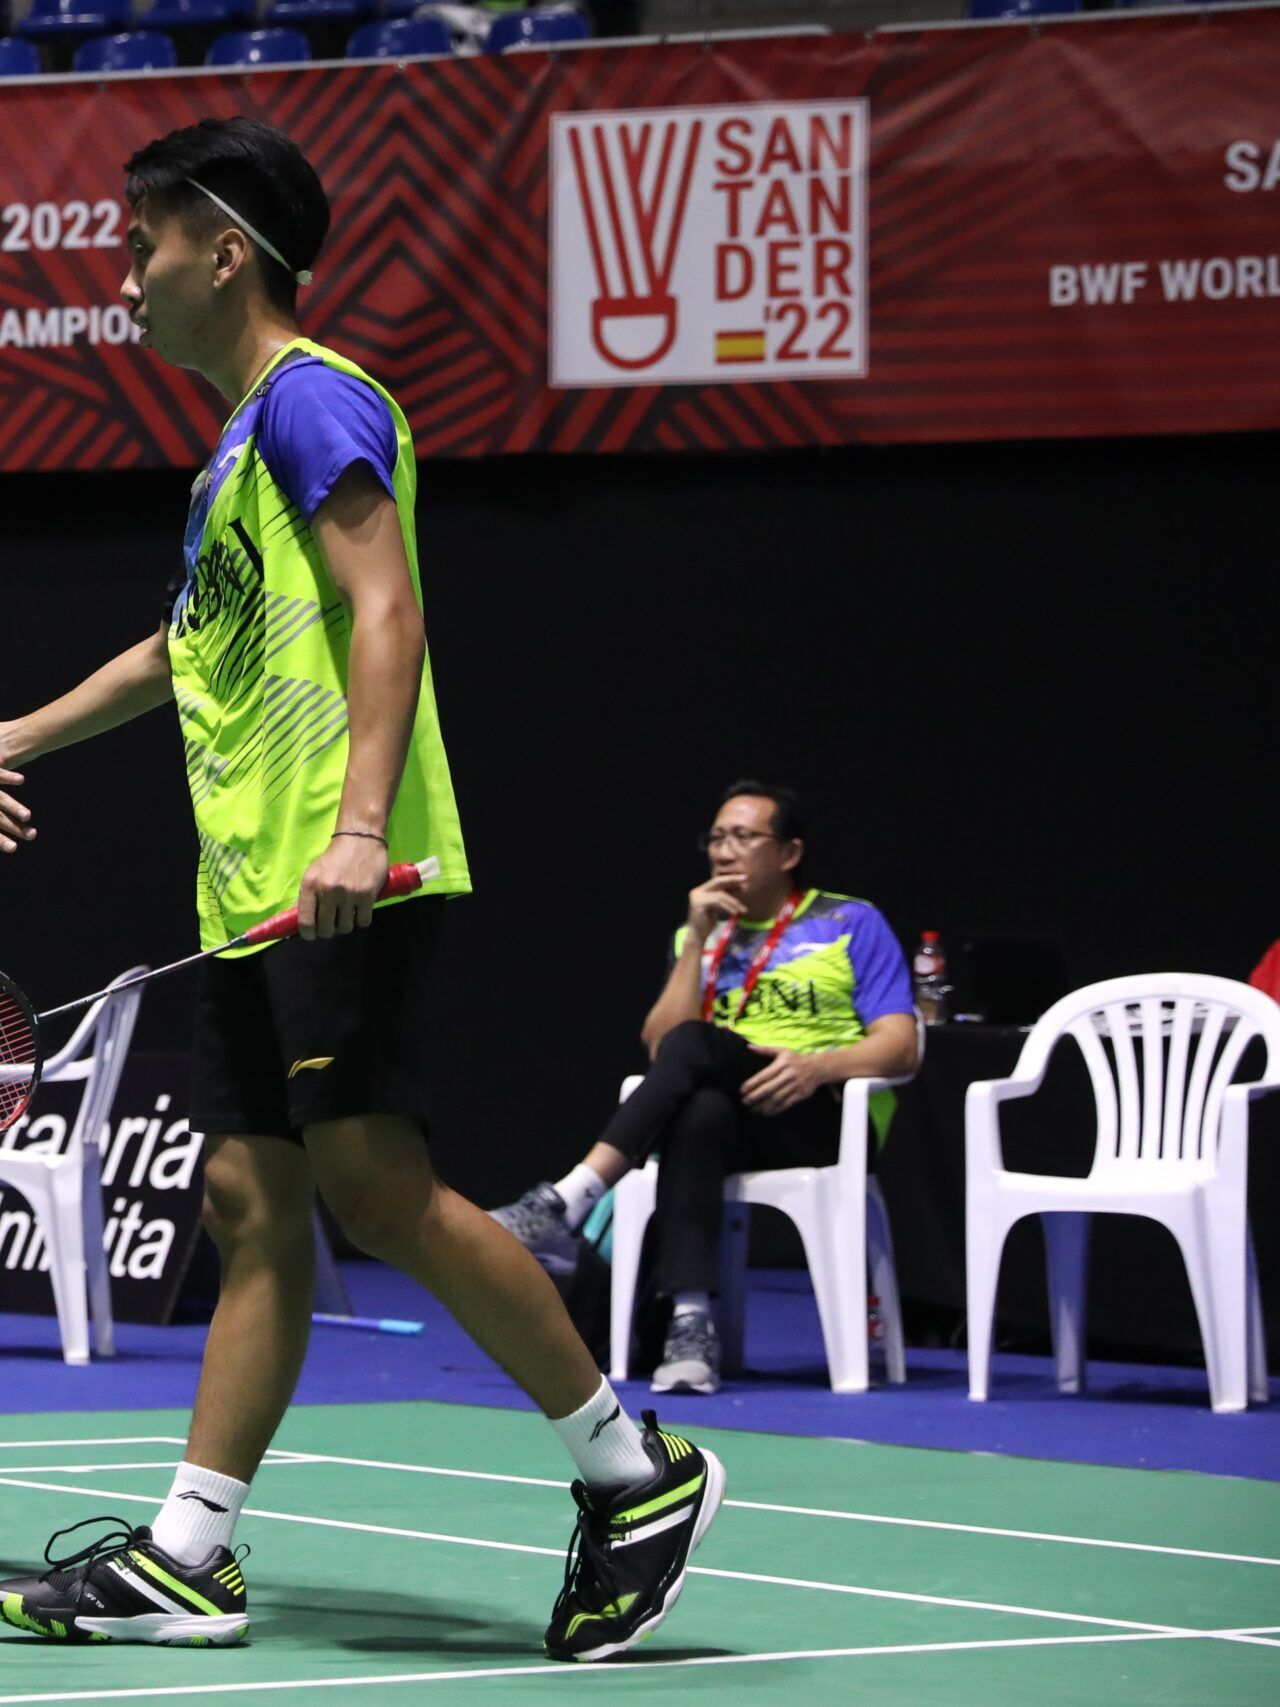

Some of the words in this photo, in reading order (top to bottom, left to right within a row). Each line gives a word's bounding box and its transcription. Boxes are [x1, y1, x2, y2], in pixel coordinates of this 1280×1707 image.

[714, 114, 851, 176] SAN
[1, 199, 122, 252] 2022
[713, 176, 851, 238] TAN
[715, 239, 852, 302] DER
[1049, 261, 1149, 307] BWF
[1159, 255, 1280, 302] WORL
